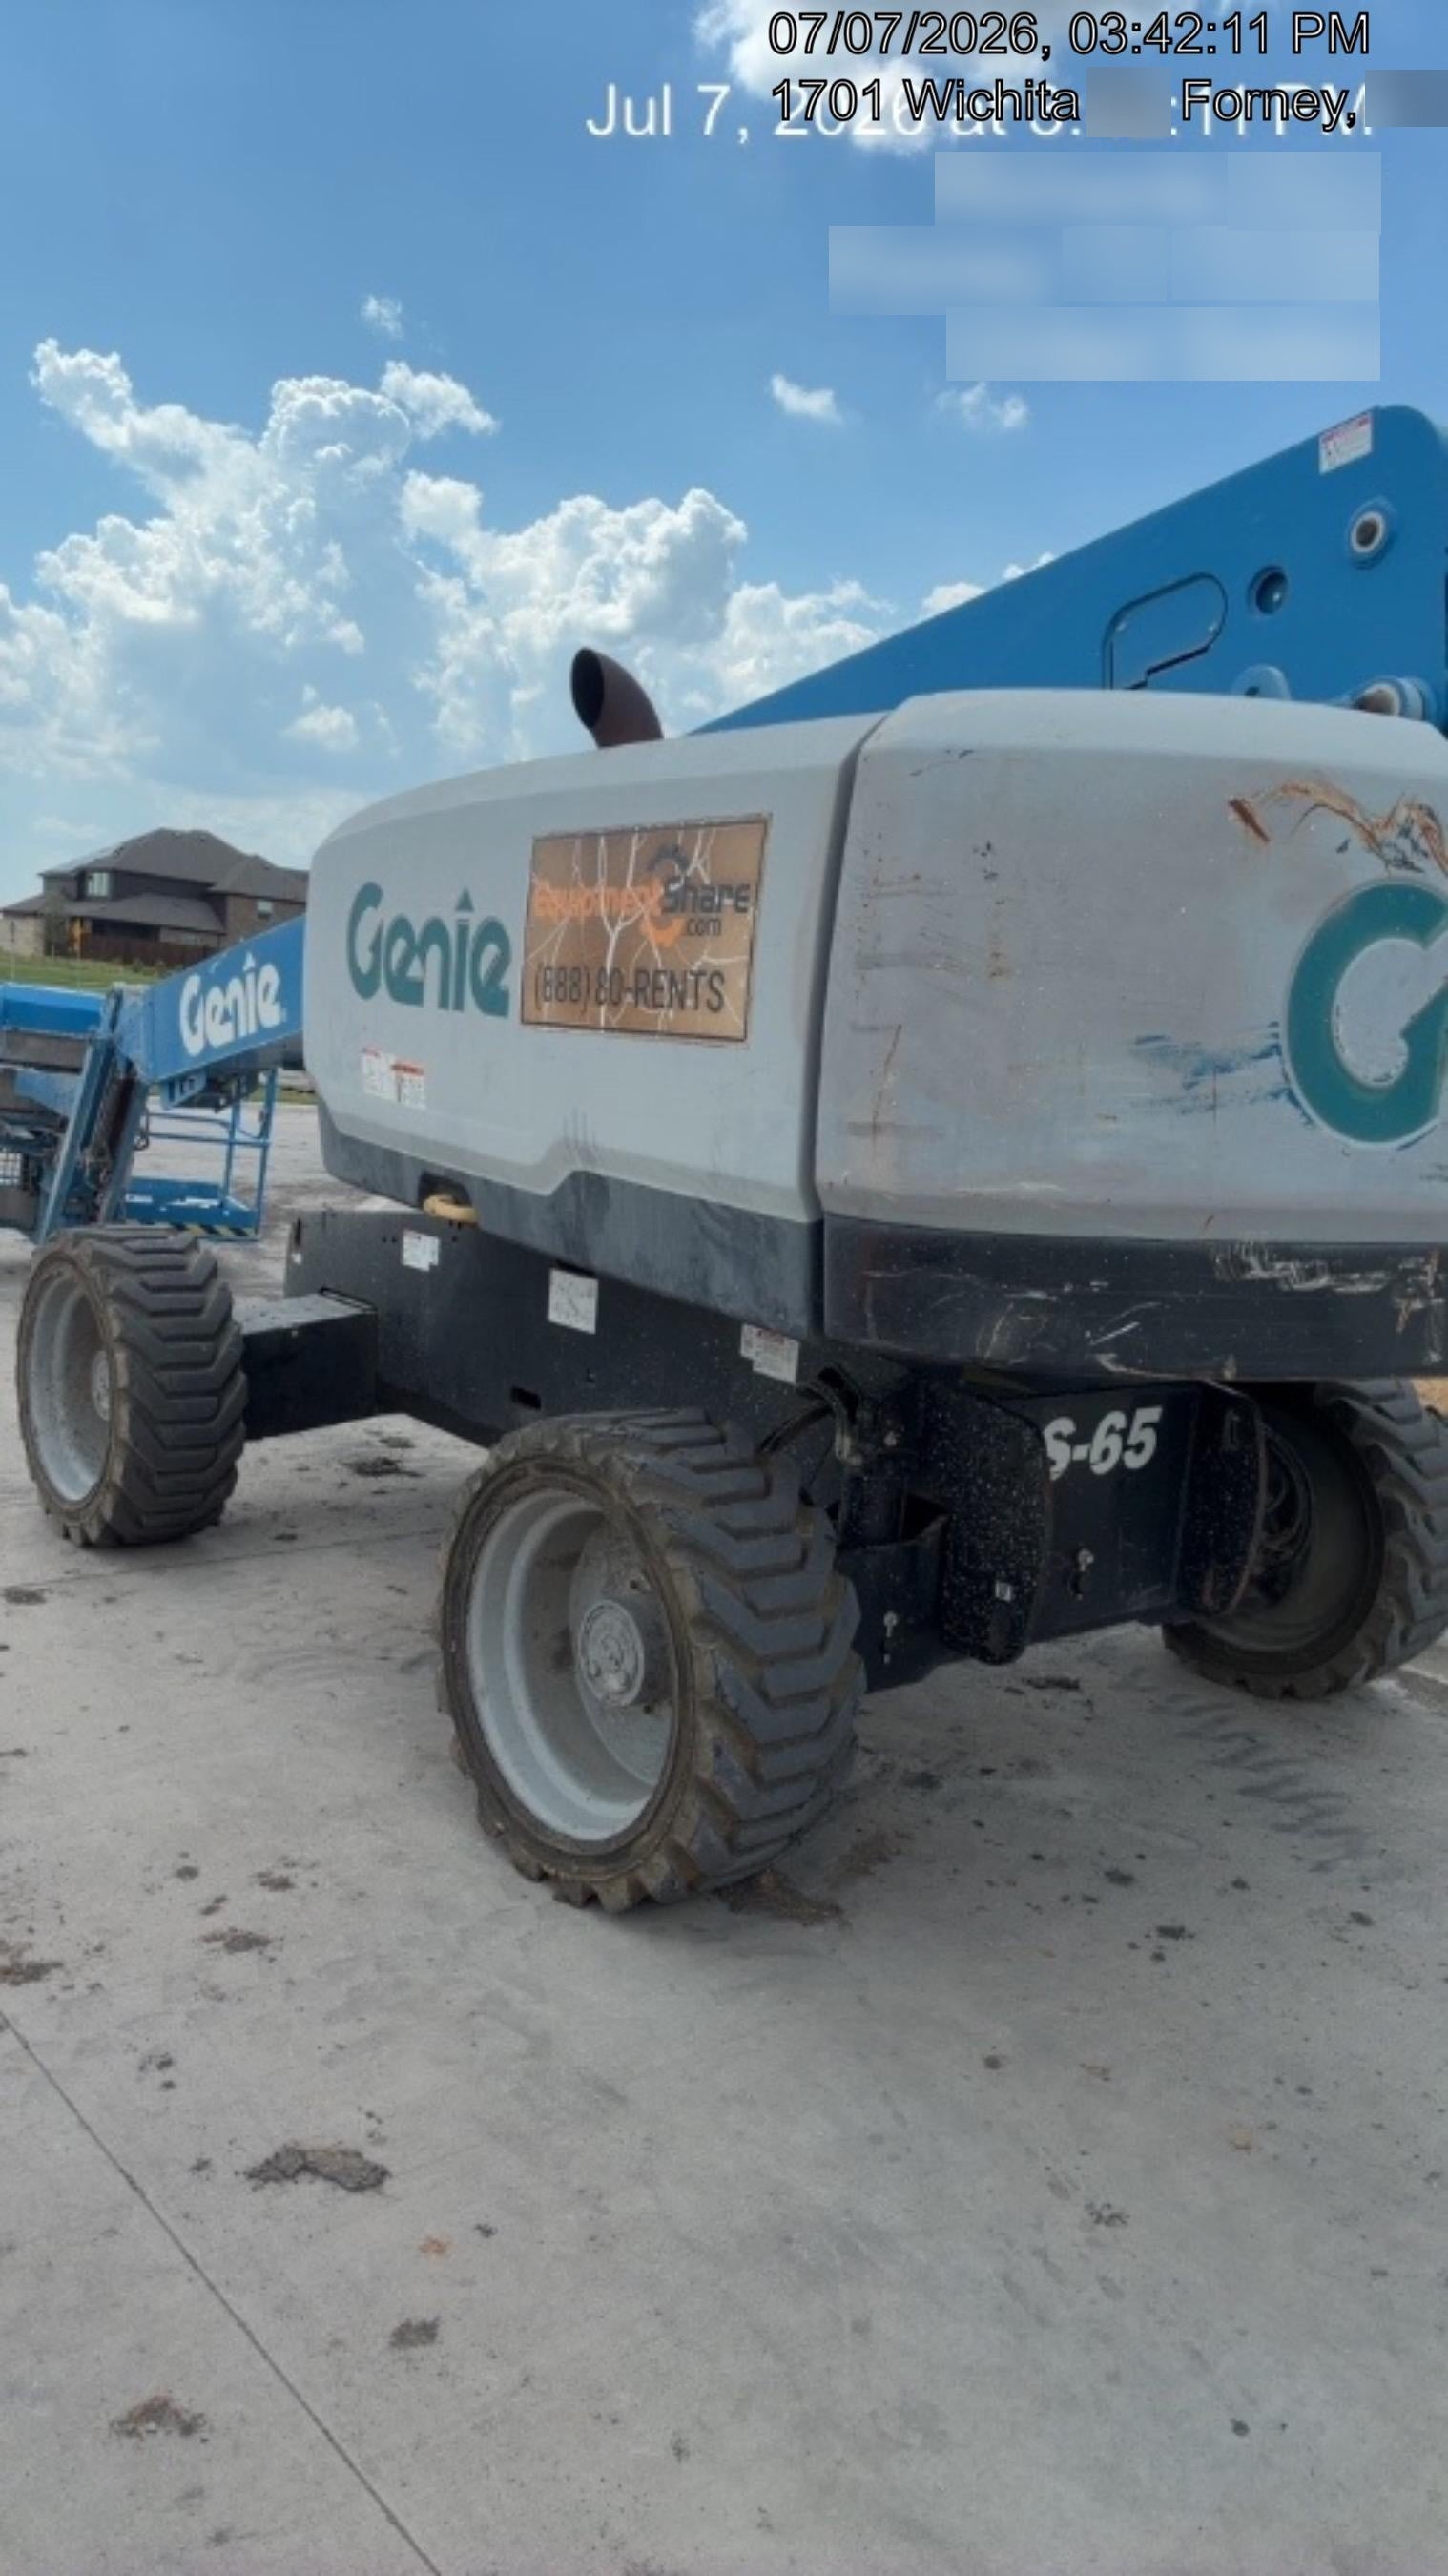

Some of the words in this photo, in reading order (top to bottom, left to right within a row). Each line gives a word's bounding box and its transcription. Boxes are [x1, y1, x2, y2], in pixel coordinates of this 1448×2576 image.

[346, 881, 511, 1018] Genie
[534, 964, 590, 1015] (888)
[594, 966, 726, 1014] 80-RENTS
[179, 951, 284, 1057] Genie
[1042, 1404, 1163, 1482] S-65
